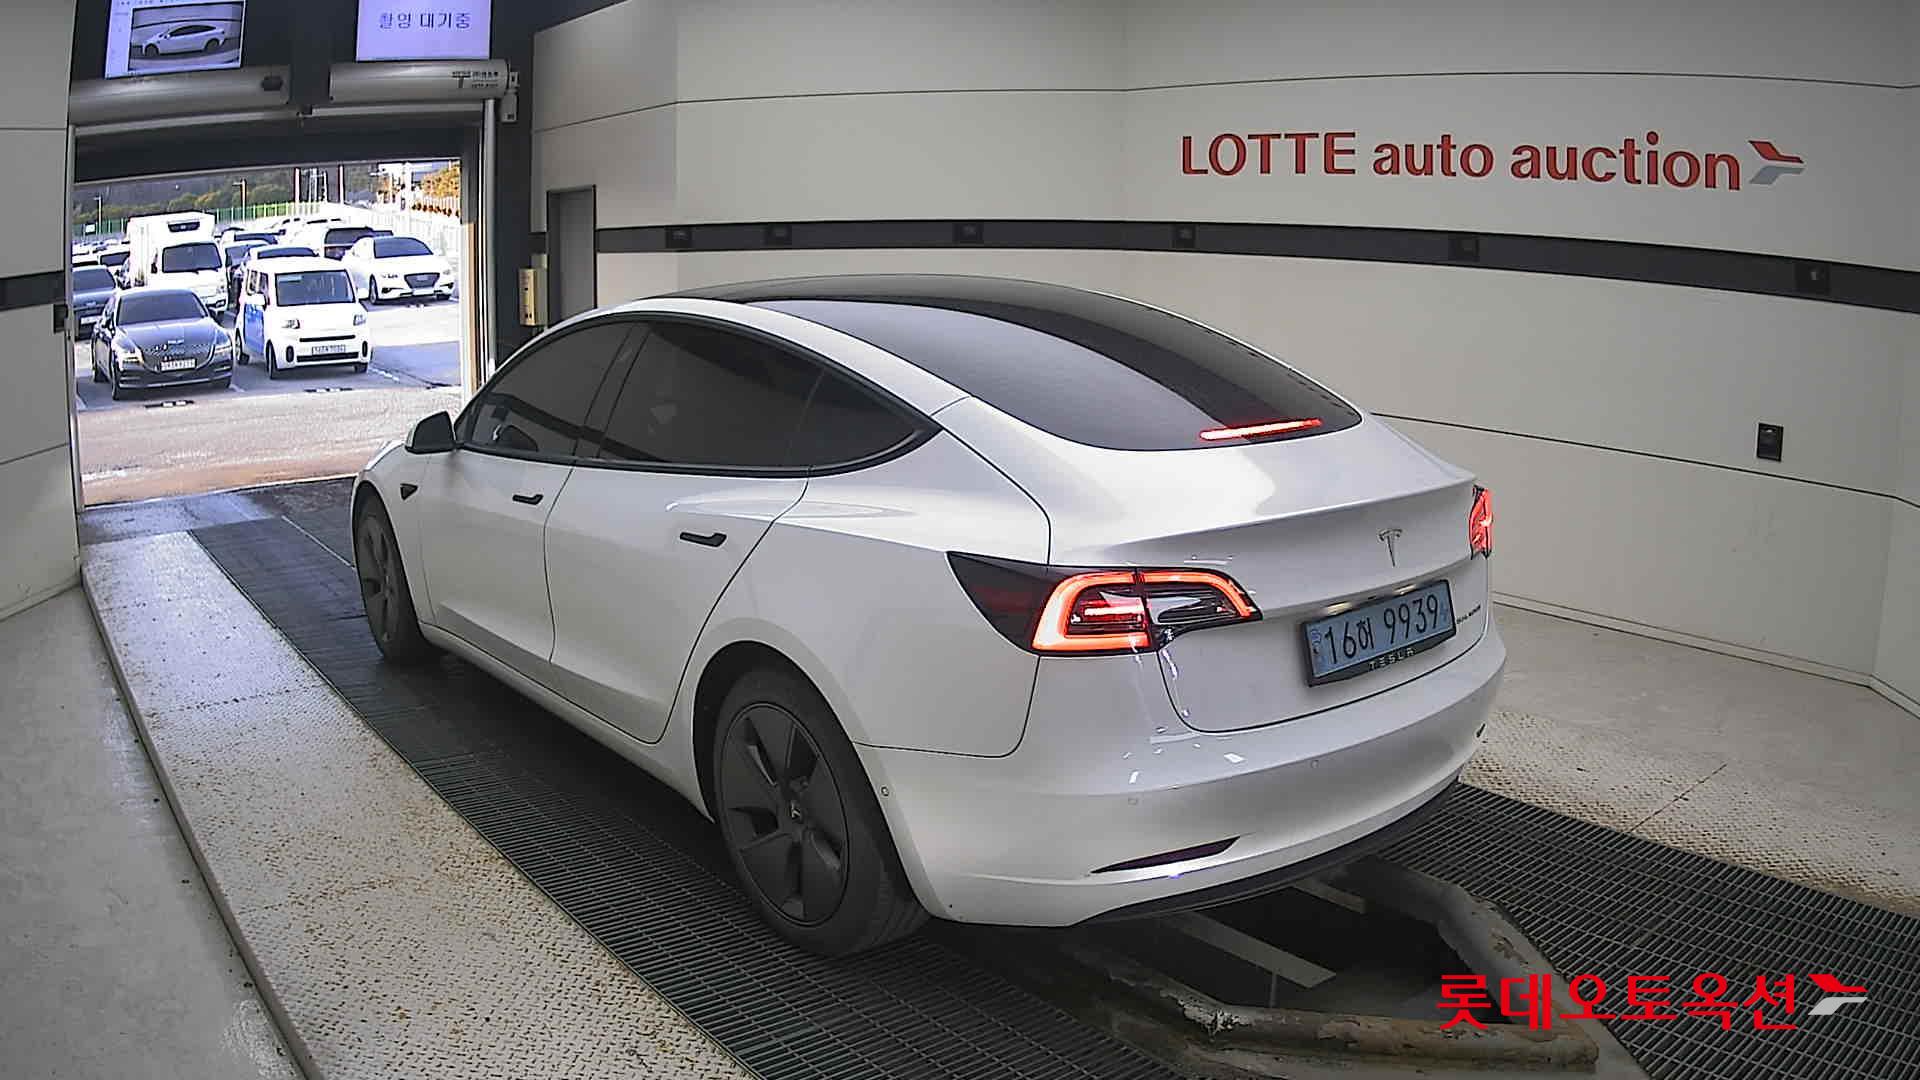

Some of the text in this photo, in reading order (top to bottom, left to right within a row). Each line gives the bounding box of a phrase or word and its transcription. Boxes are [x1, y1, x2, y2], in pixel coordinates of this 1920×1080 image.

[420, 12, 471, 29] 대기중
[1182, 131, 1740, 190] LOTTE auto auction
[1383, 594, 1438, 645] 9939
[1368, 647, 1417, 672] TESLA
